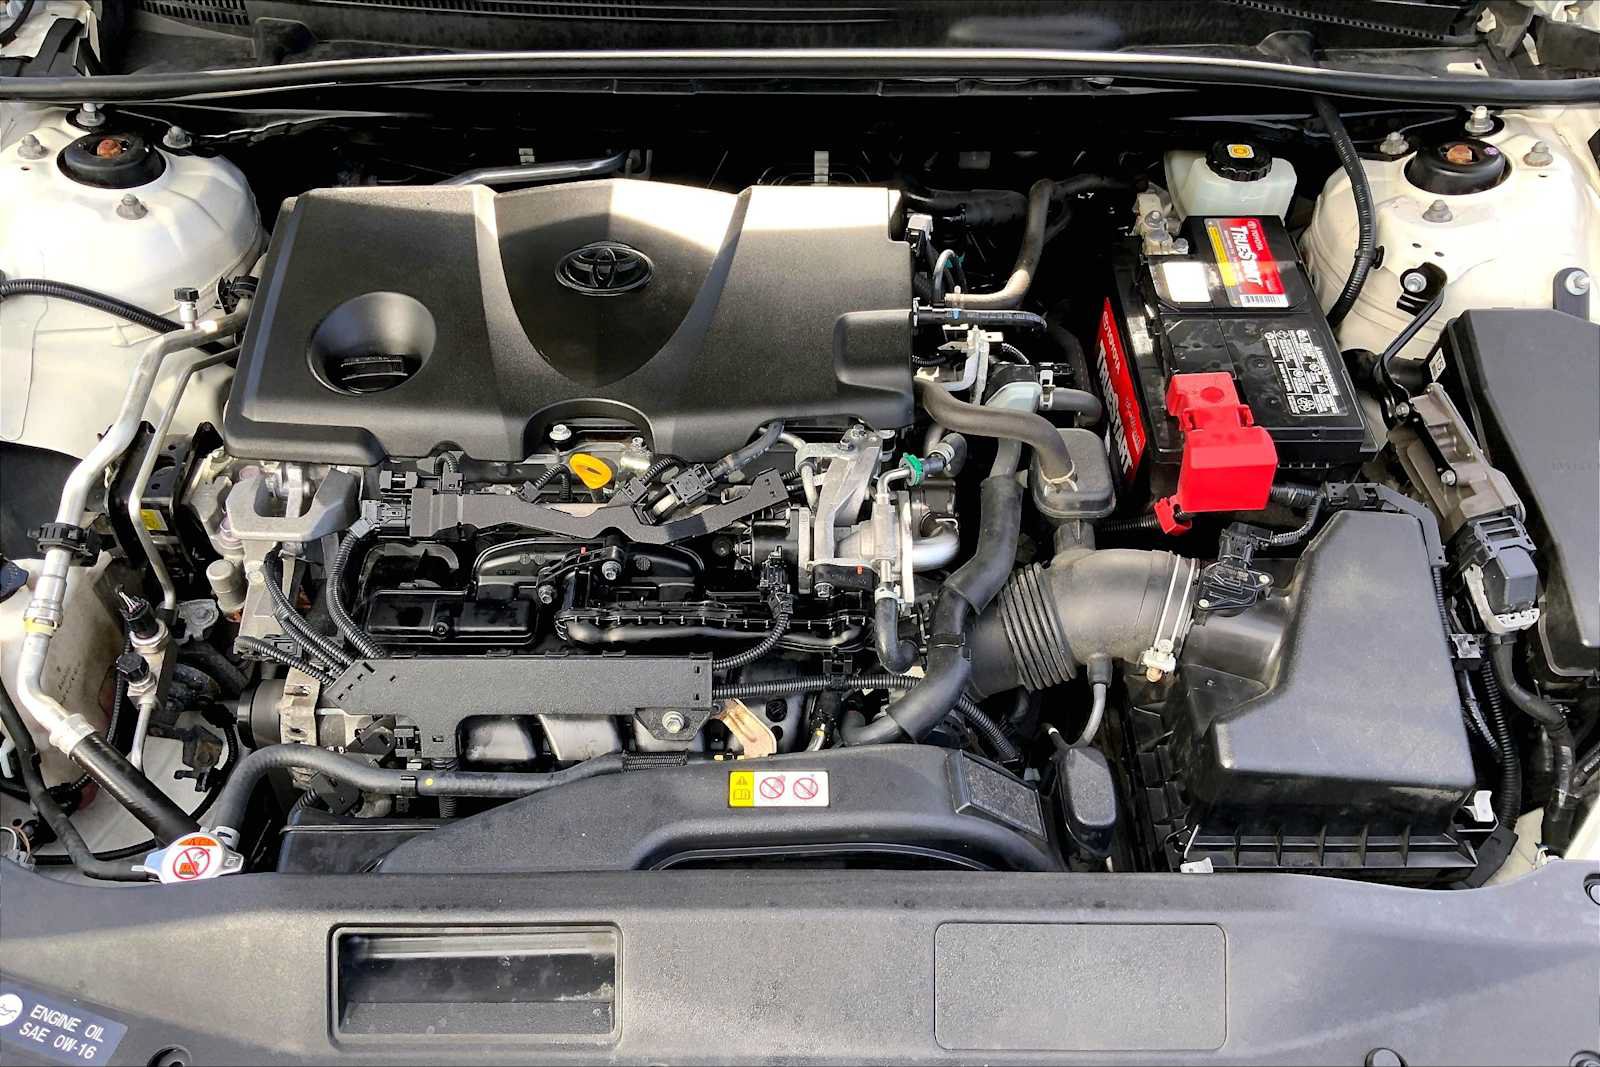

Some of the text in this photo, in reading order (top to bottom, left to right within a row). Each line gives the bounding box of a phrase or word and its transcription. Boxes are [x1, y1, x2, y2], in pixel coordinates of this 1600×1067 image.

[1251, 229, 1264, 251] TOYOTA
[1105, 327, 1120, 375] TOYOTA
[1097, 339, 1133, 475] TRUESTART
[19, 1022, 97, 1060] SAE 0W-16
[30, 1004, 105, 1043] ENGINE OIL
